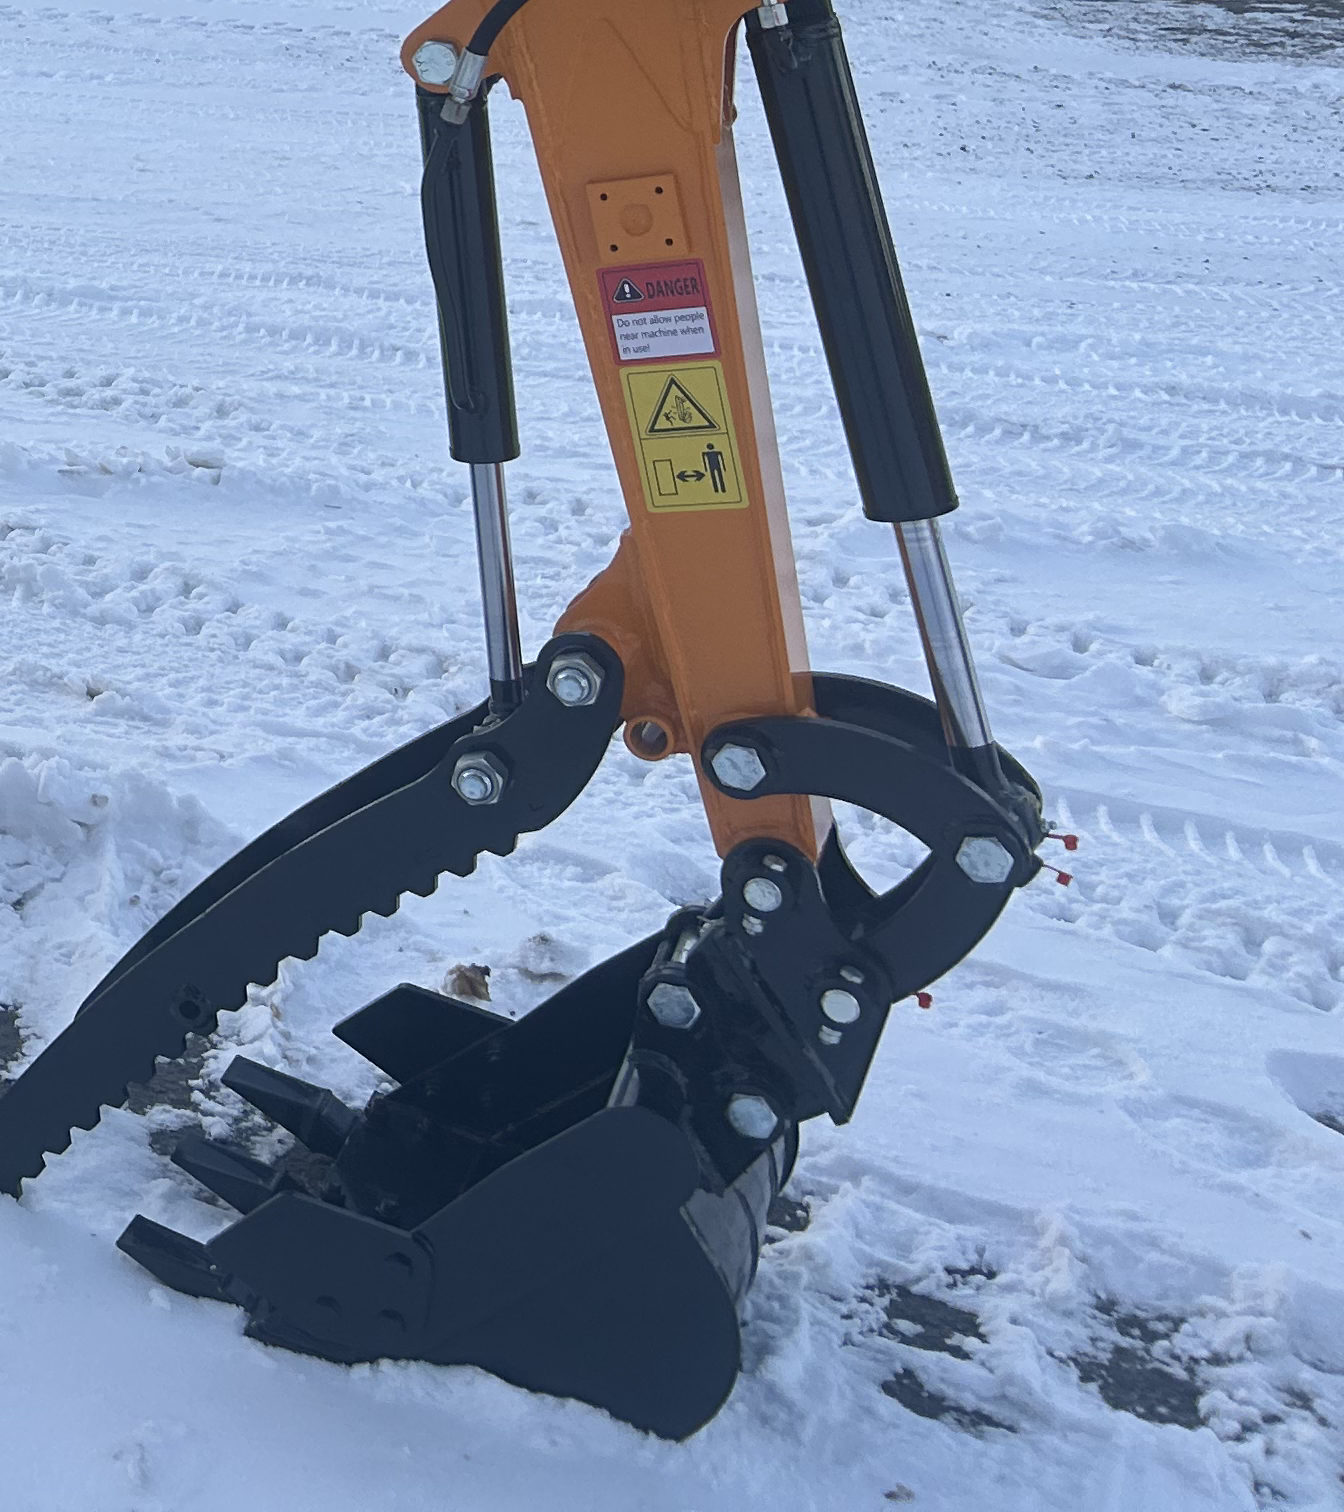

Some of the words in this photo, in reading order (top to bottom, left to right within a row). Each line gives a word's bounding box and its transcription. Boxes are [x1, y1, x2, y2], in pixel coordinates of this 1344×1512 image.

[645, 276, 700, 299] DANGER
[617, 318, 630, 327] Do
[632, 317, 647, 326] not
[650, 314, 672, 324] allow
[674, 311, 705, 323] people
[619, 331, 638, 341] near
[641, 327, 678, 339] machine
[680, 326, 705, 336] when
